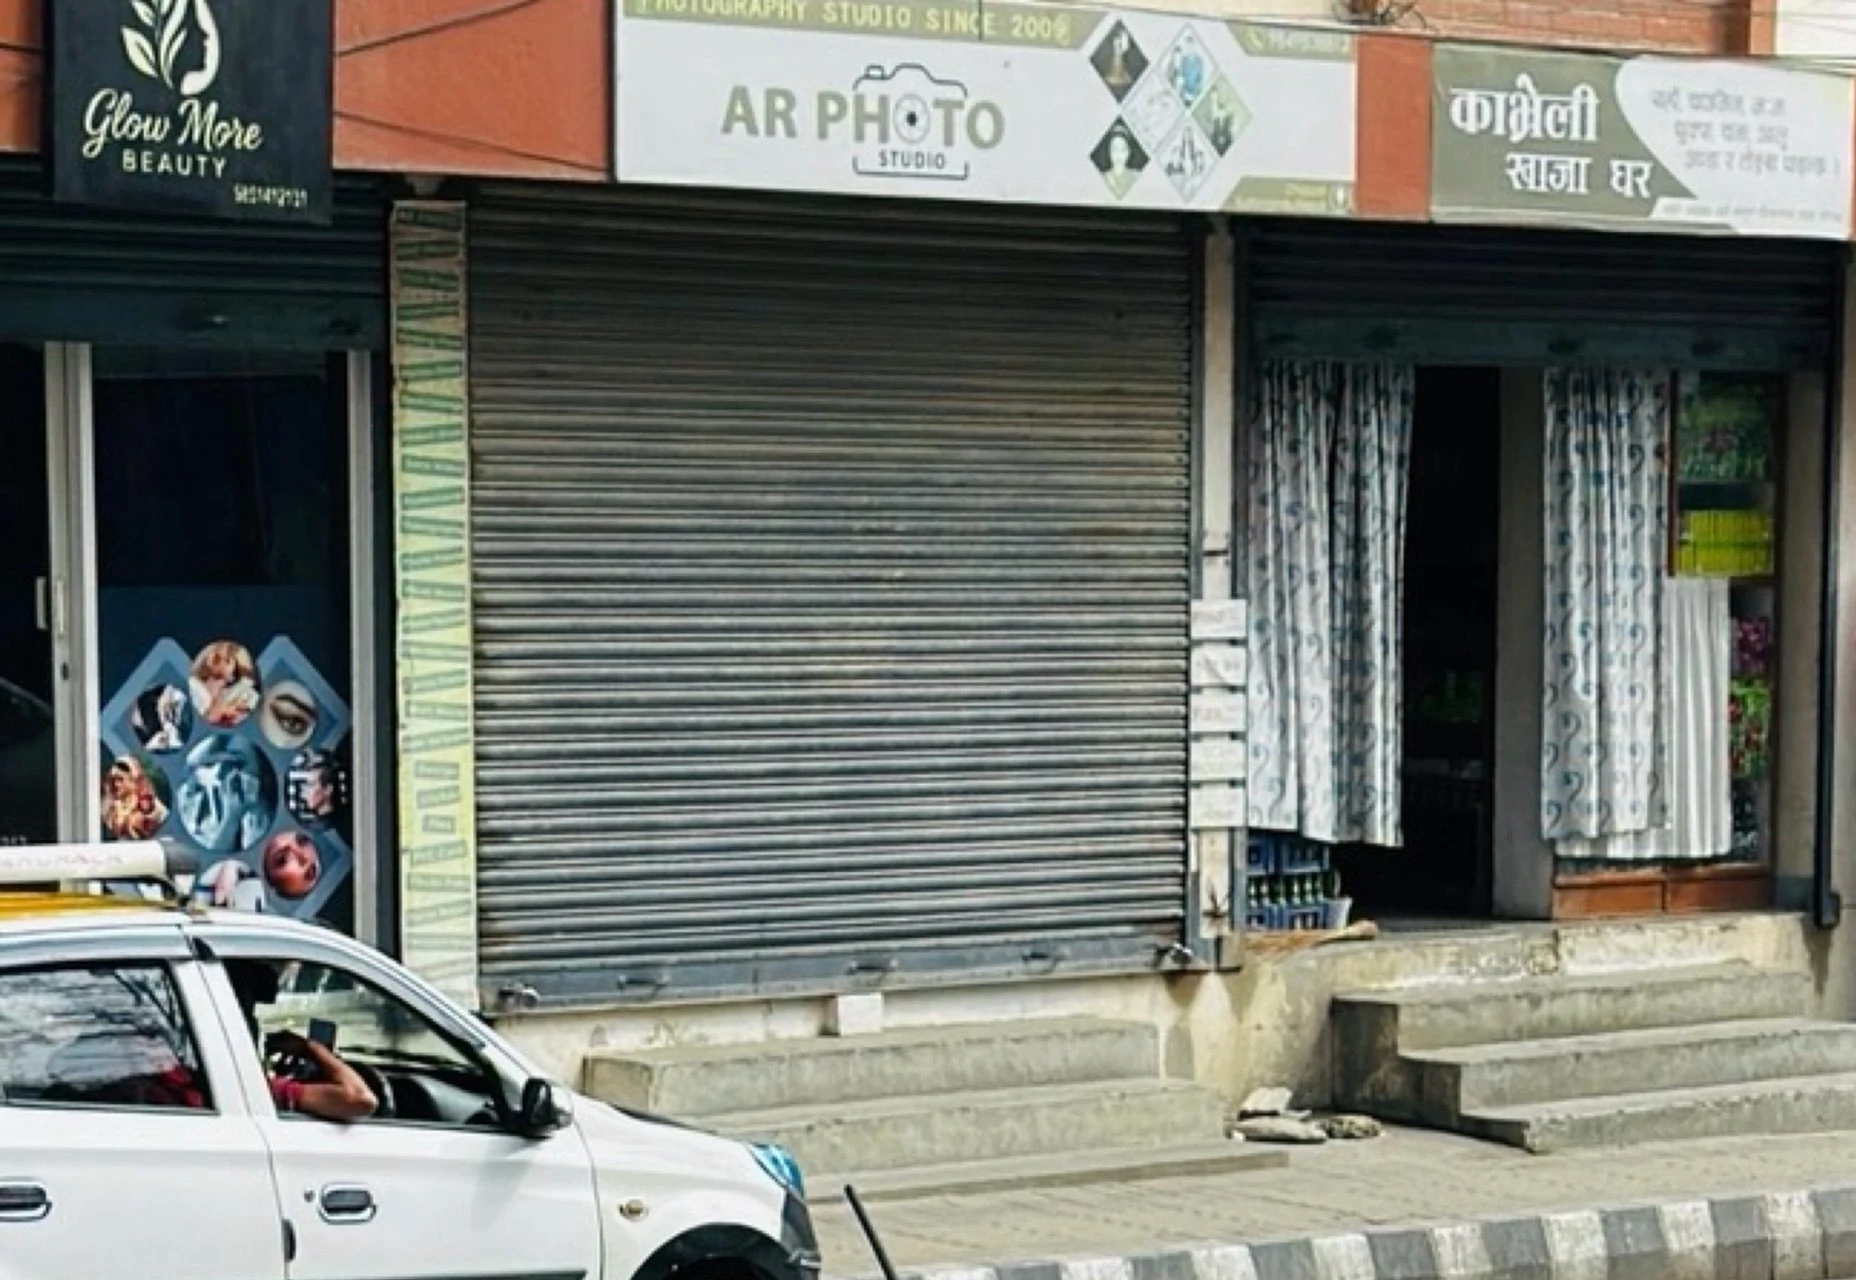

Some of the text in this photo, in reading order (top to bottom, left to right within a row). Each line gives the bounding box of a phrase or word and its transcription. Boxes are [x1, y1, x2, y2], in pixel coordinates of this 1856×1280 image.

[824, 1, 911, 28] STUDIO
[926, 9, 996, 35] SINCE
[83, 88, 264, 158] Glow More
[721, 85, 1006, 150] AR PHOTO
[122, 149, 228, 179] BEAUTY
[879, 151, 946, 169] STUDIO
[1504, 153, 1594, 195] खाजा
[1609, 159, 1654, 198] घर
